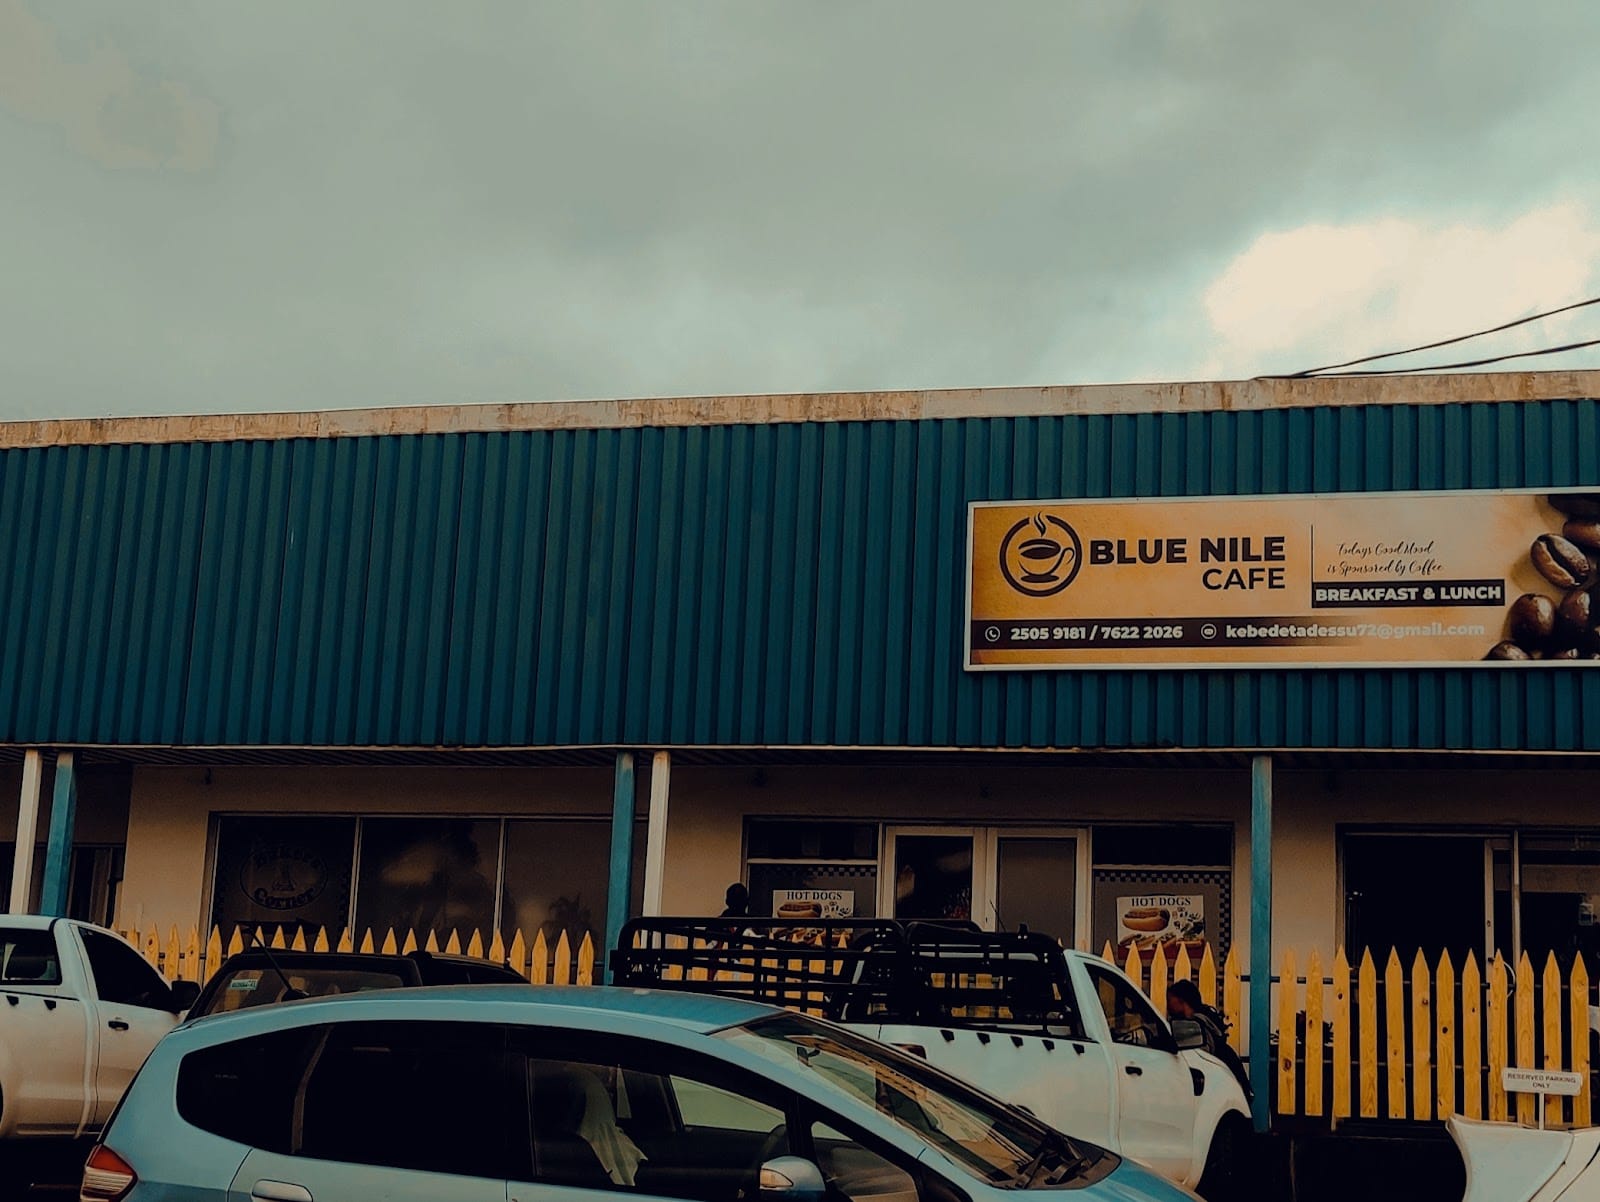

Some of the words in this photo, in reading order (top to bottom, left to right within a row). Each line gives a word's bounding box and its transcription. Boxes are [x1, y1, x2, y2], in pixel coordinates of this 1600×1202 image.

[1089, 538, 1187, 565] BLUE
[1200, 536, 1286, 563] NILE
[1337, 541, 1372, 559] Todays
[1375, 540, 1404, 556] Good
[1404, 540, 1434, 556] Mood
[1327, 564, 1337, 574] is
[1339, 559, 1394, 577] Sponsored
[1394, 559, 1406, 576] by
[1409, 558, 1442, 576] Coffee
[1202, 567, 1286, 591] CAFE
[1315, 587, 1419, 601] BREAKFAST
[1422, 587, 1436, 600] &
[1440, 586, 1501, 600] LUNCH
[1010, 627, 1049, 641] 2505
[1053, 626, 1086, 641] 9181
[1089, 625, 1099, 641] /
[1101, 626, 1140, 640] 7622
[1143, 625, 1183, 640] 2026
[1226, 621, 1485, 640] kebedetadessu72@gmail.com
[787, 891, 811, 900] HOT
[812, 891, 842, 901] DOGS
[1131, 897, 1156, 907] HOT
[1159, 896, 1191, 906] DOGS
[1507, 1073, 1544, 1081] RESERVED
[1546, 1075, 1576, 1084] PARKING
